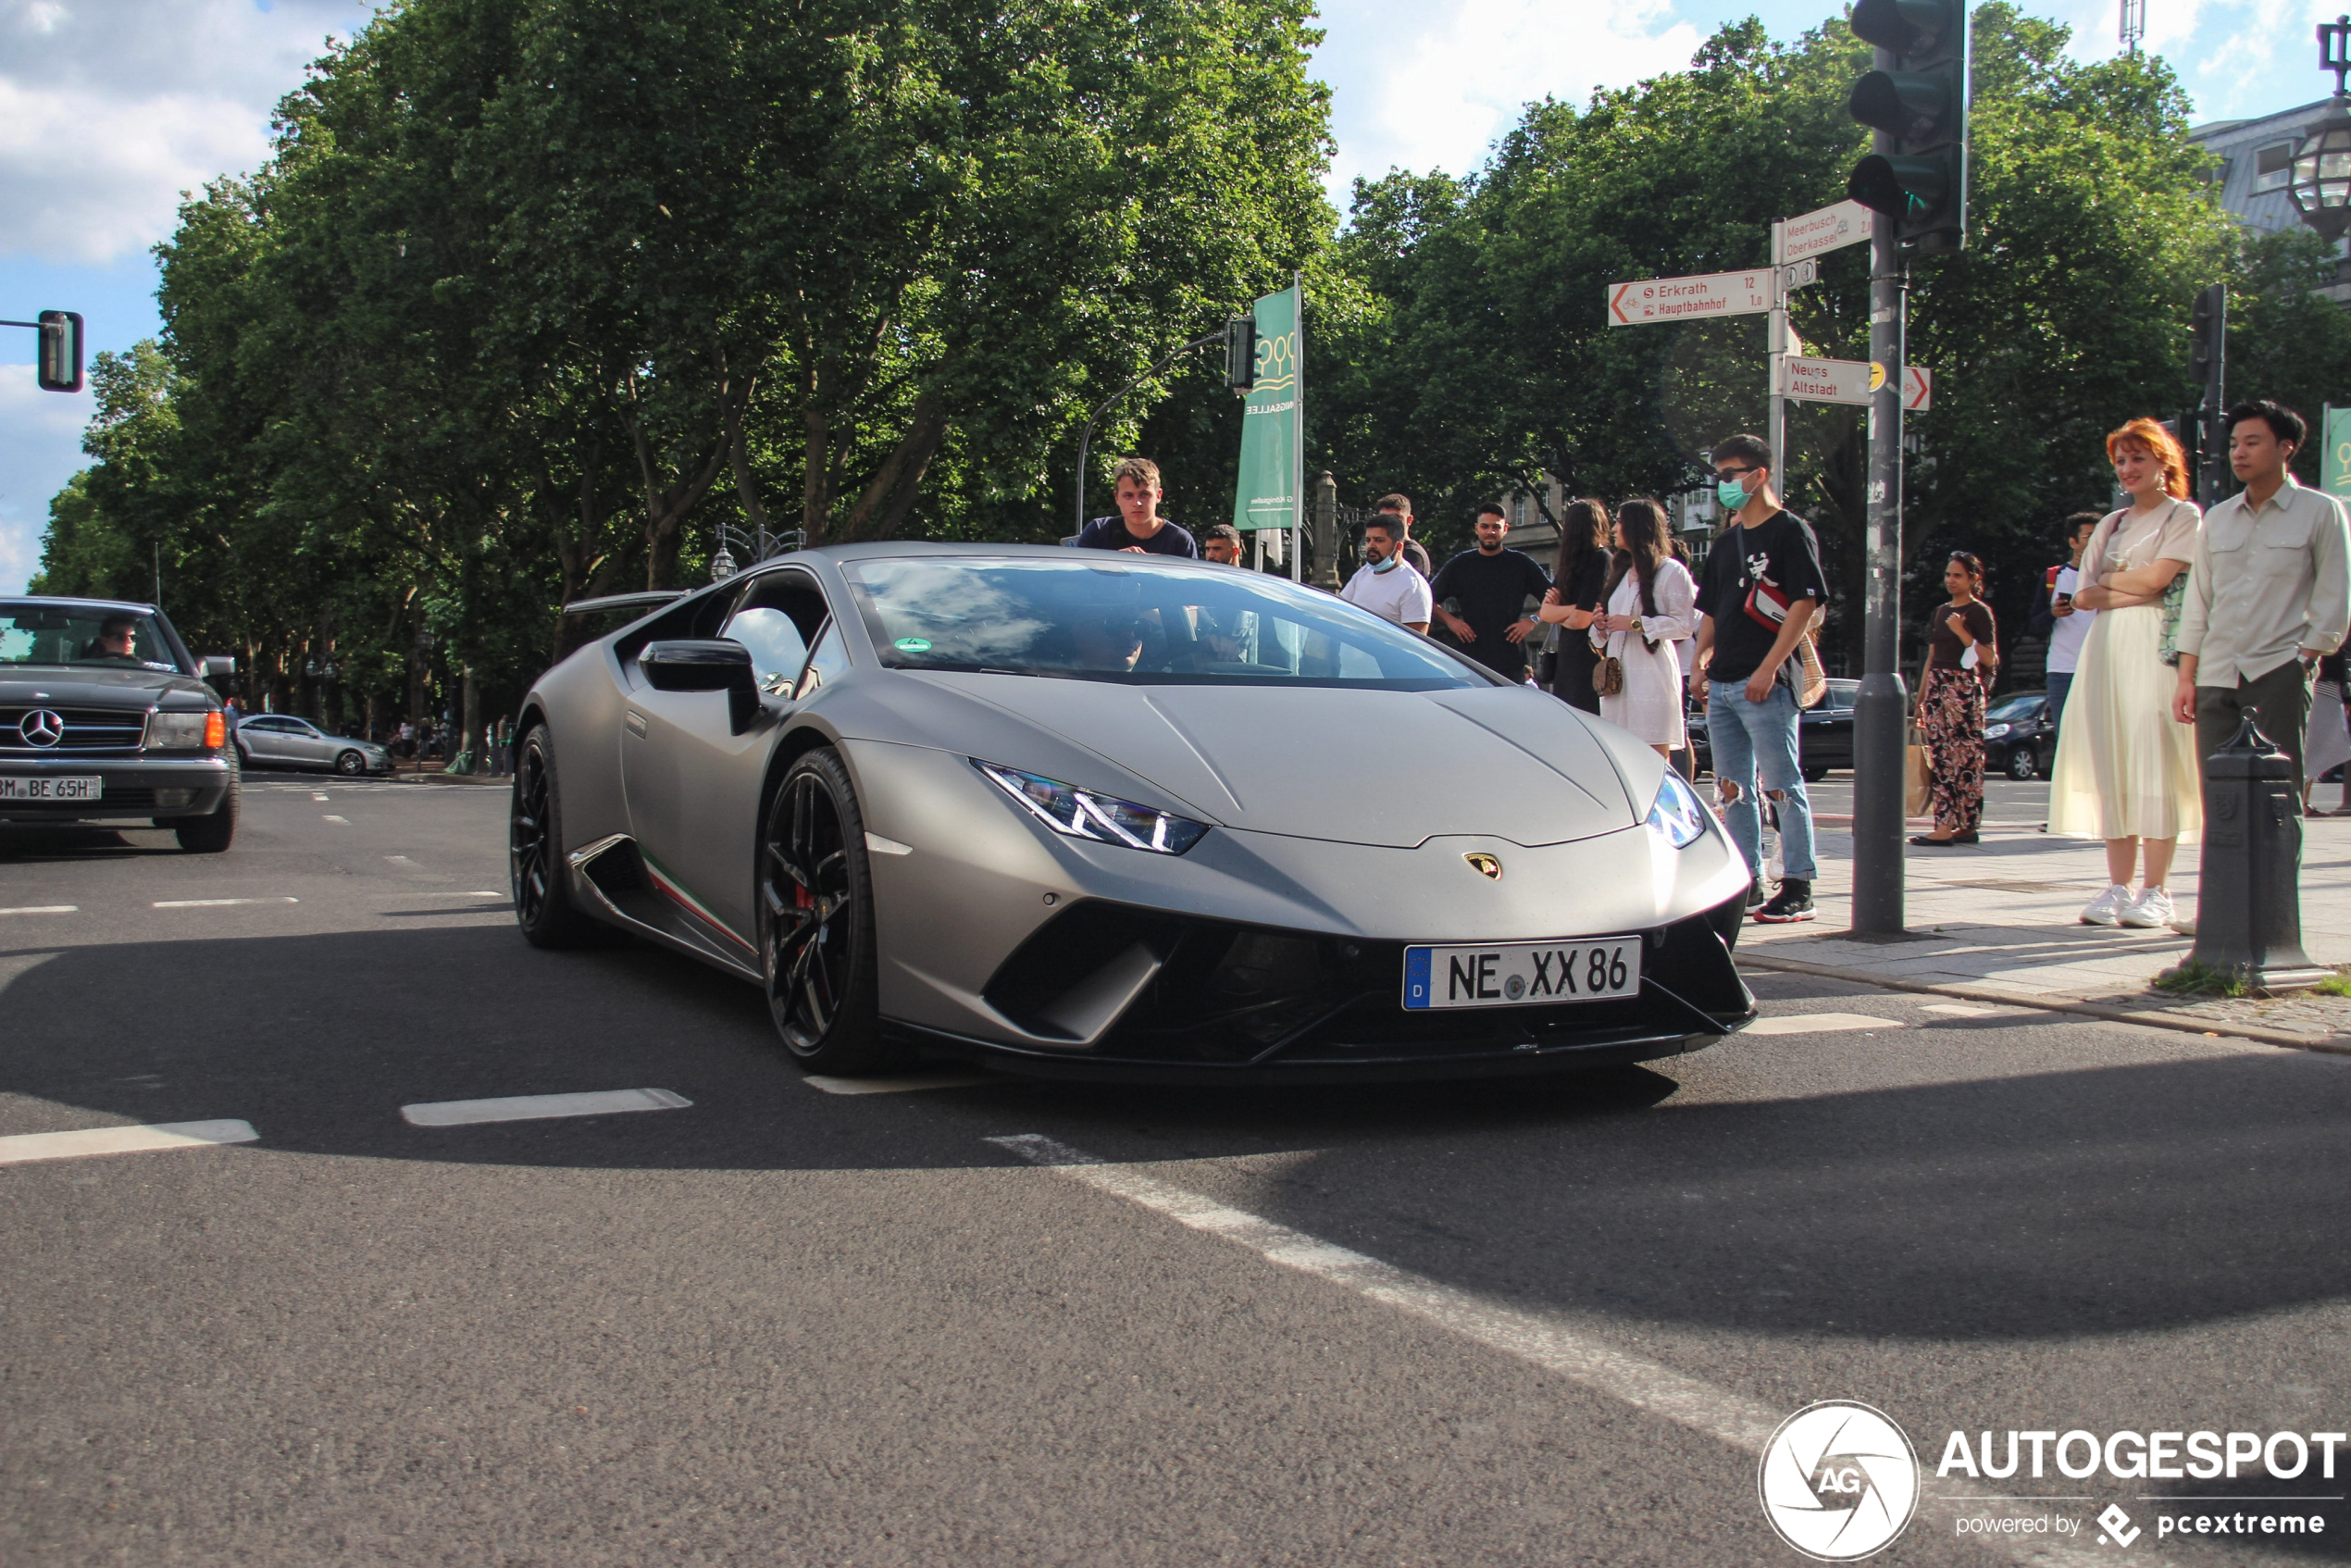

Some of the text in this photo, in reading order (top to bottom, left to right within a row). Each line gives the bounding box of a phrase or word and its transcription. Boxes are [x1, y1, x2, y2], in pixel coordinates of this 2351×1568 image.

[1787, 213, 1836, 239] Meerbusch
[1787, 230, 1837, 255] Oberkassel
[1660, 282, 1707, 298] Erkrath
[1745, 277, 1754, 289] 12
[1659, 297, 1726, 316] Hauptbahnhof
[1791, 380, 1837, 396] Altstadt
[30, 779, 51, 797] BE
[56, 779, 88, 797] 65H
[1449, 946, 1627, 1001] NE XX 86
[1412, 984, 1423, 998] D
